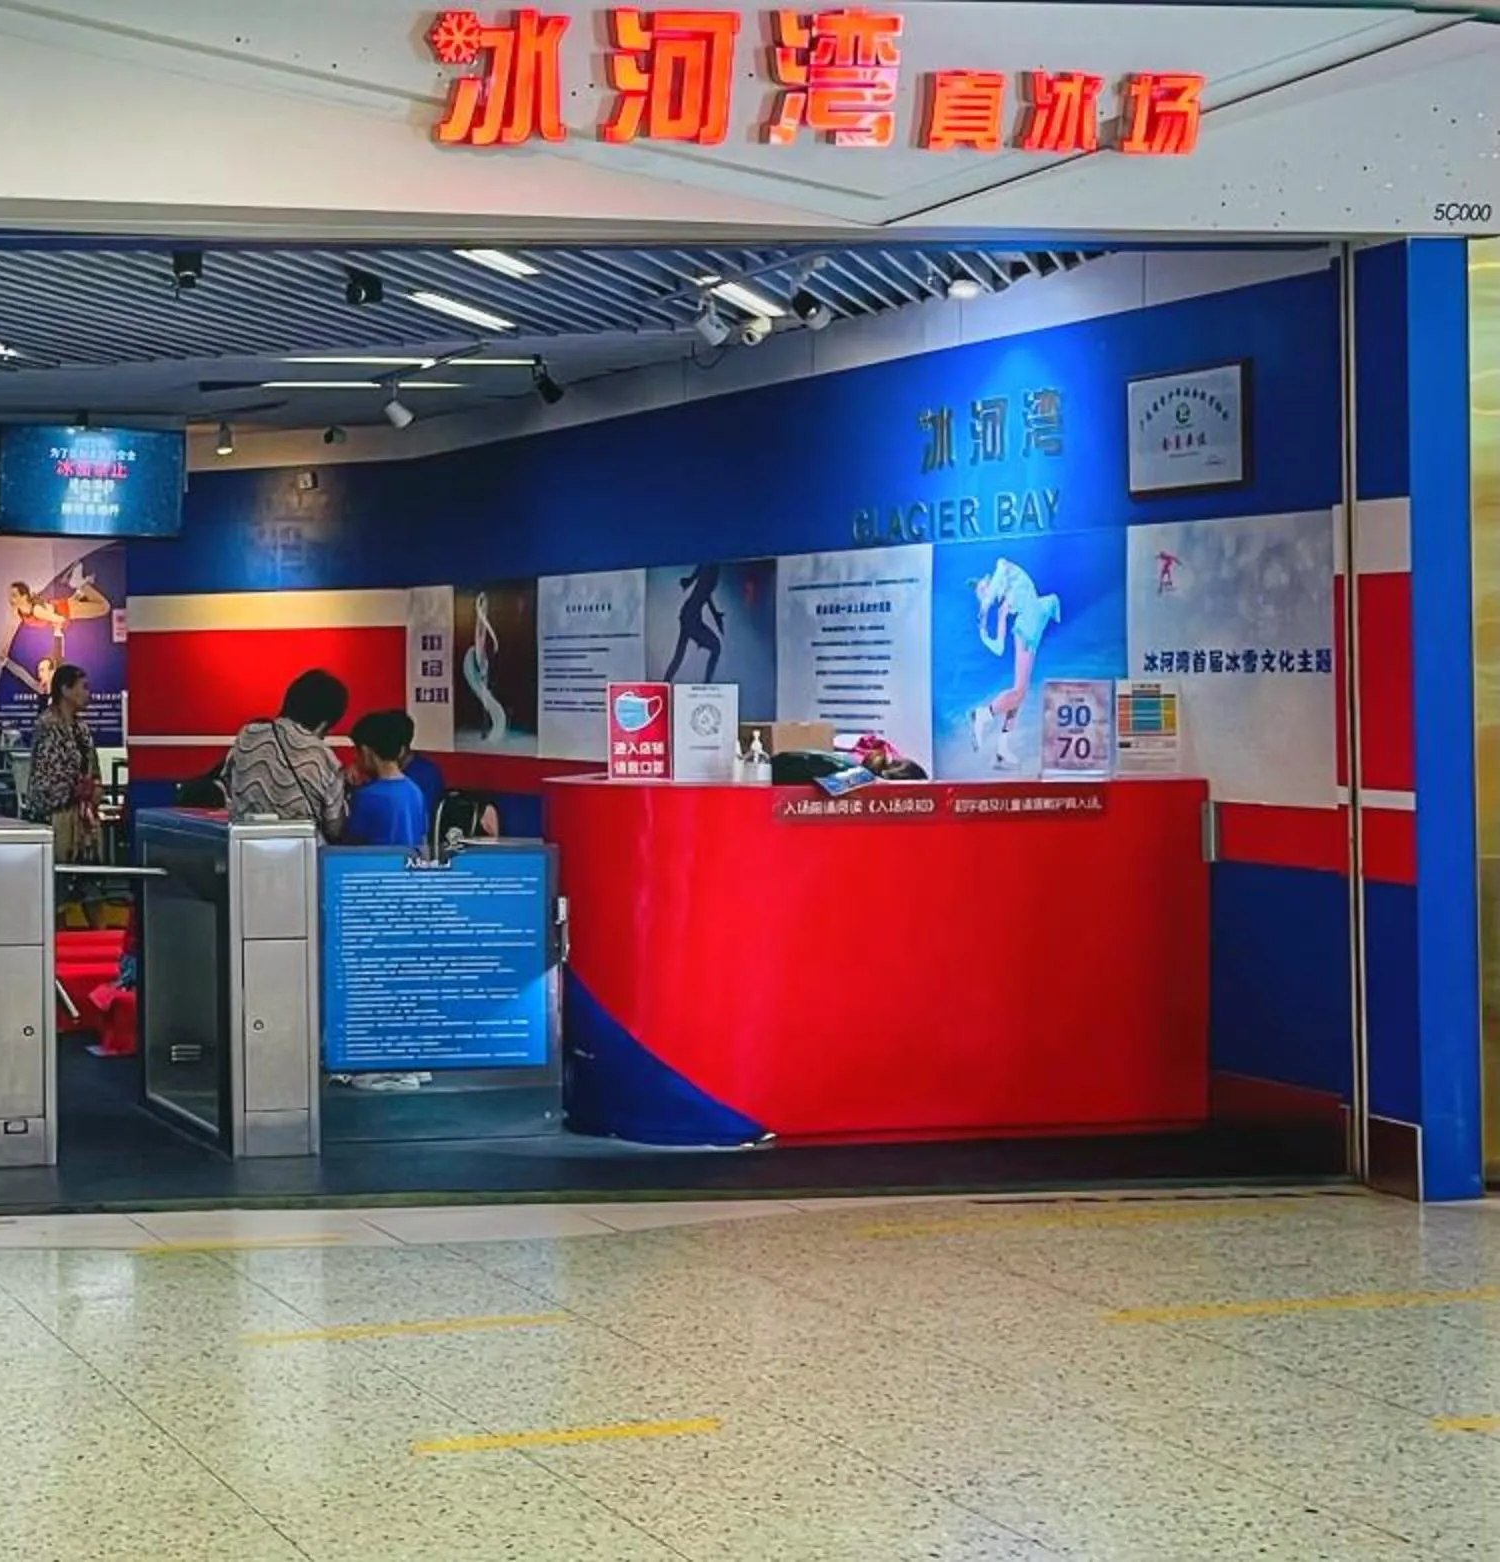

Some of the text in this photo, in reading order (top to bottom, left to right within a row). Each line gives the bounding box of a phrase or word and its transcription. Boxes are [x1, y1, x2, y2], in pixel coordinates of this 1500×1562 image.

[430, 7, 1206, 157] 冰河湾 真冰场
[1433, 203, 1492, 222] 5C000
[917, 388, 1063, 475] 冰河湾
[853, 488, 1060, 545] GLACIER BAY
[1143, 648, 1333, 674] 冰河湾首届冰雪文化主题
[1057, 705, 1092, 728] 90
[1057, 737, 1091, 760] 70
